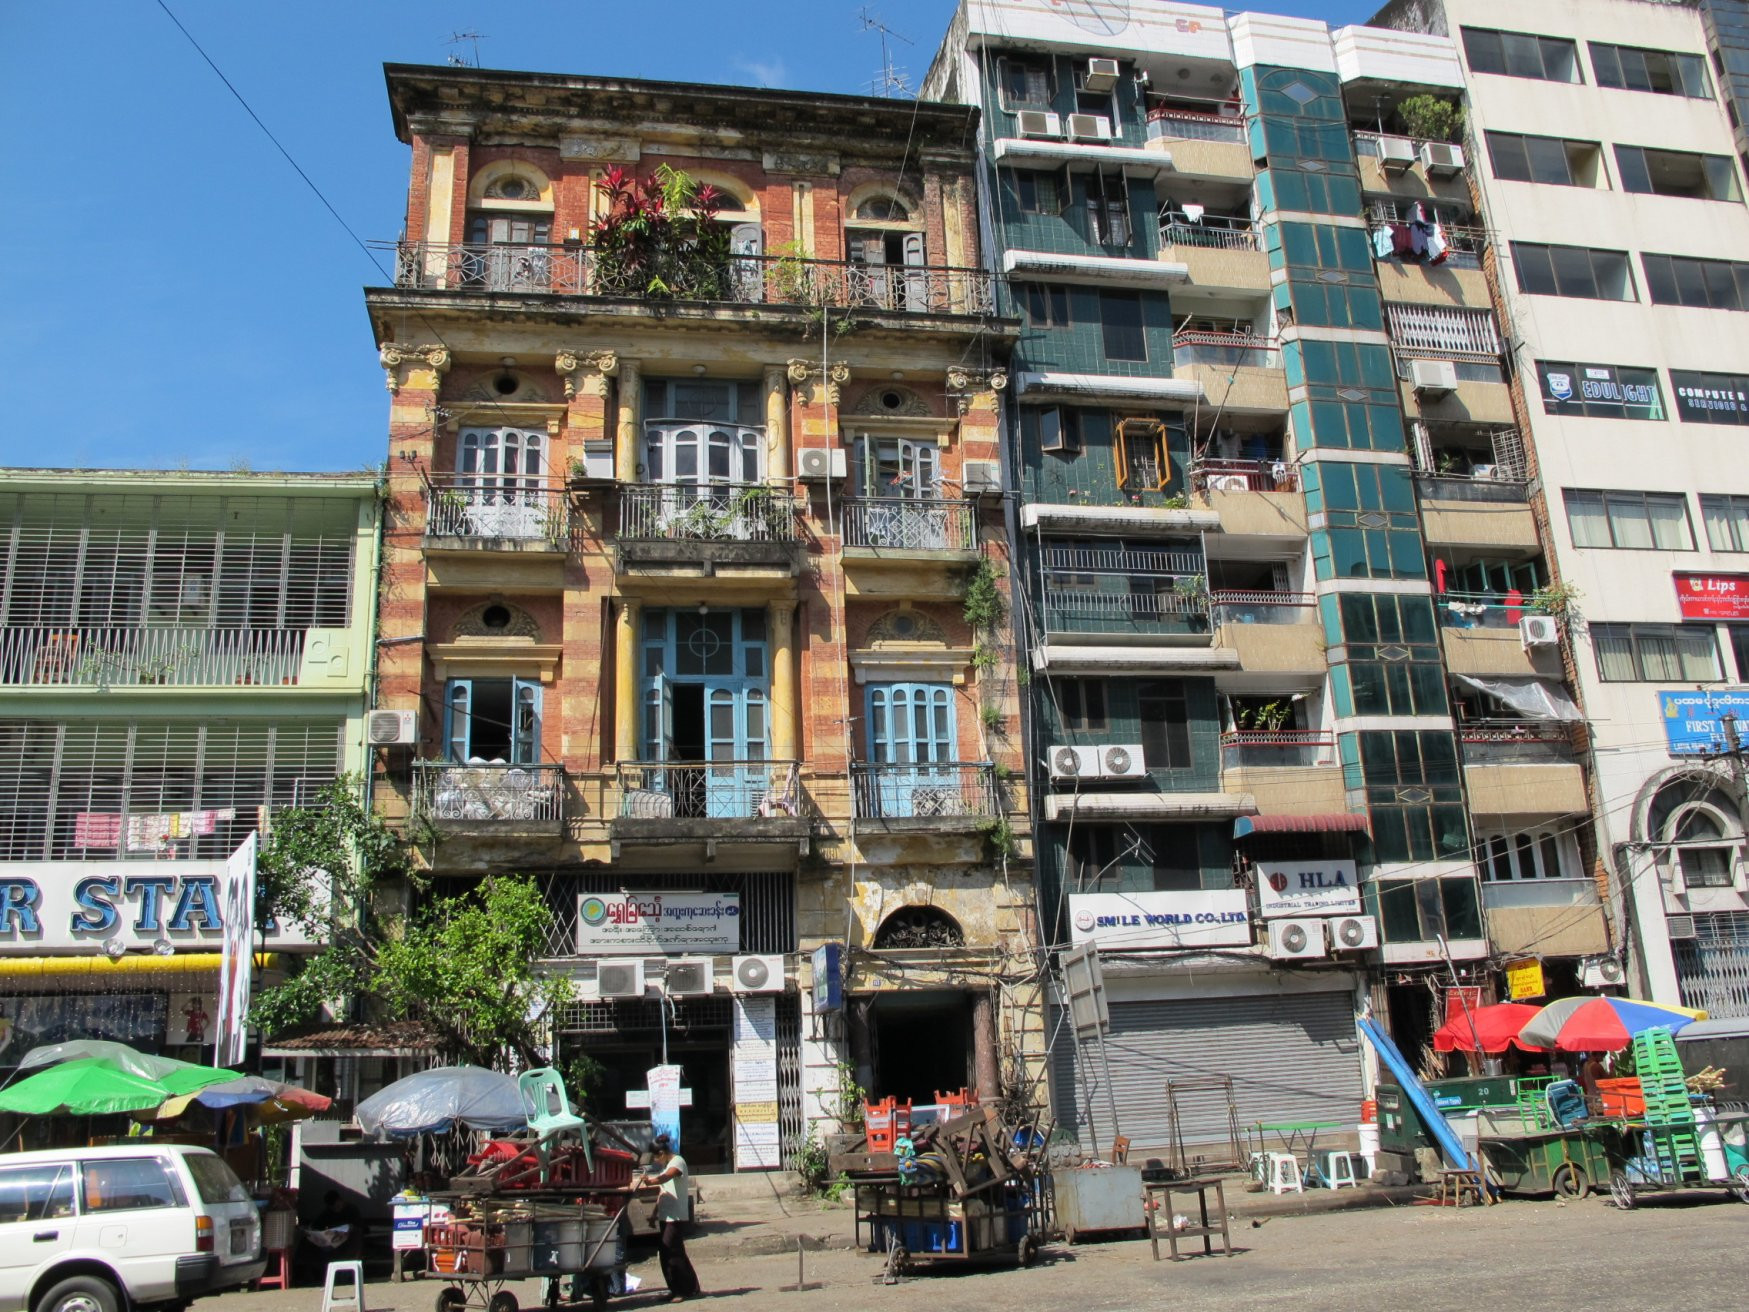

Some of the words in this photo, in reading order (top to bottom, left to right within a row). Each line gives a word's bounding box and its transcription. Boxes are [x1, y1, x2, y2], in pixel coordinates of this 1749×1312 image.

[1582, 380, 1657, 403] EDULIGHT
[1678, 387, 1746, 401] COMPUTER
[1707, 578, 1737, 595] Lips
[1685, 720, 1715, 733] FIRST
[1298, 869, 1349, 889] HLA
[70, 874, 278, 932] STA
[1097, 914, 1142, 928] SMILE
[1144, 913, 1194, 926] WORLD
[1477, 1087, 1489, 1096] 20
